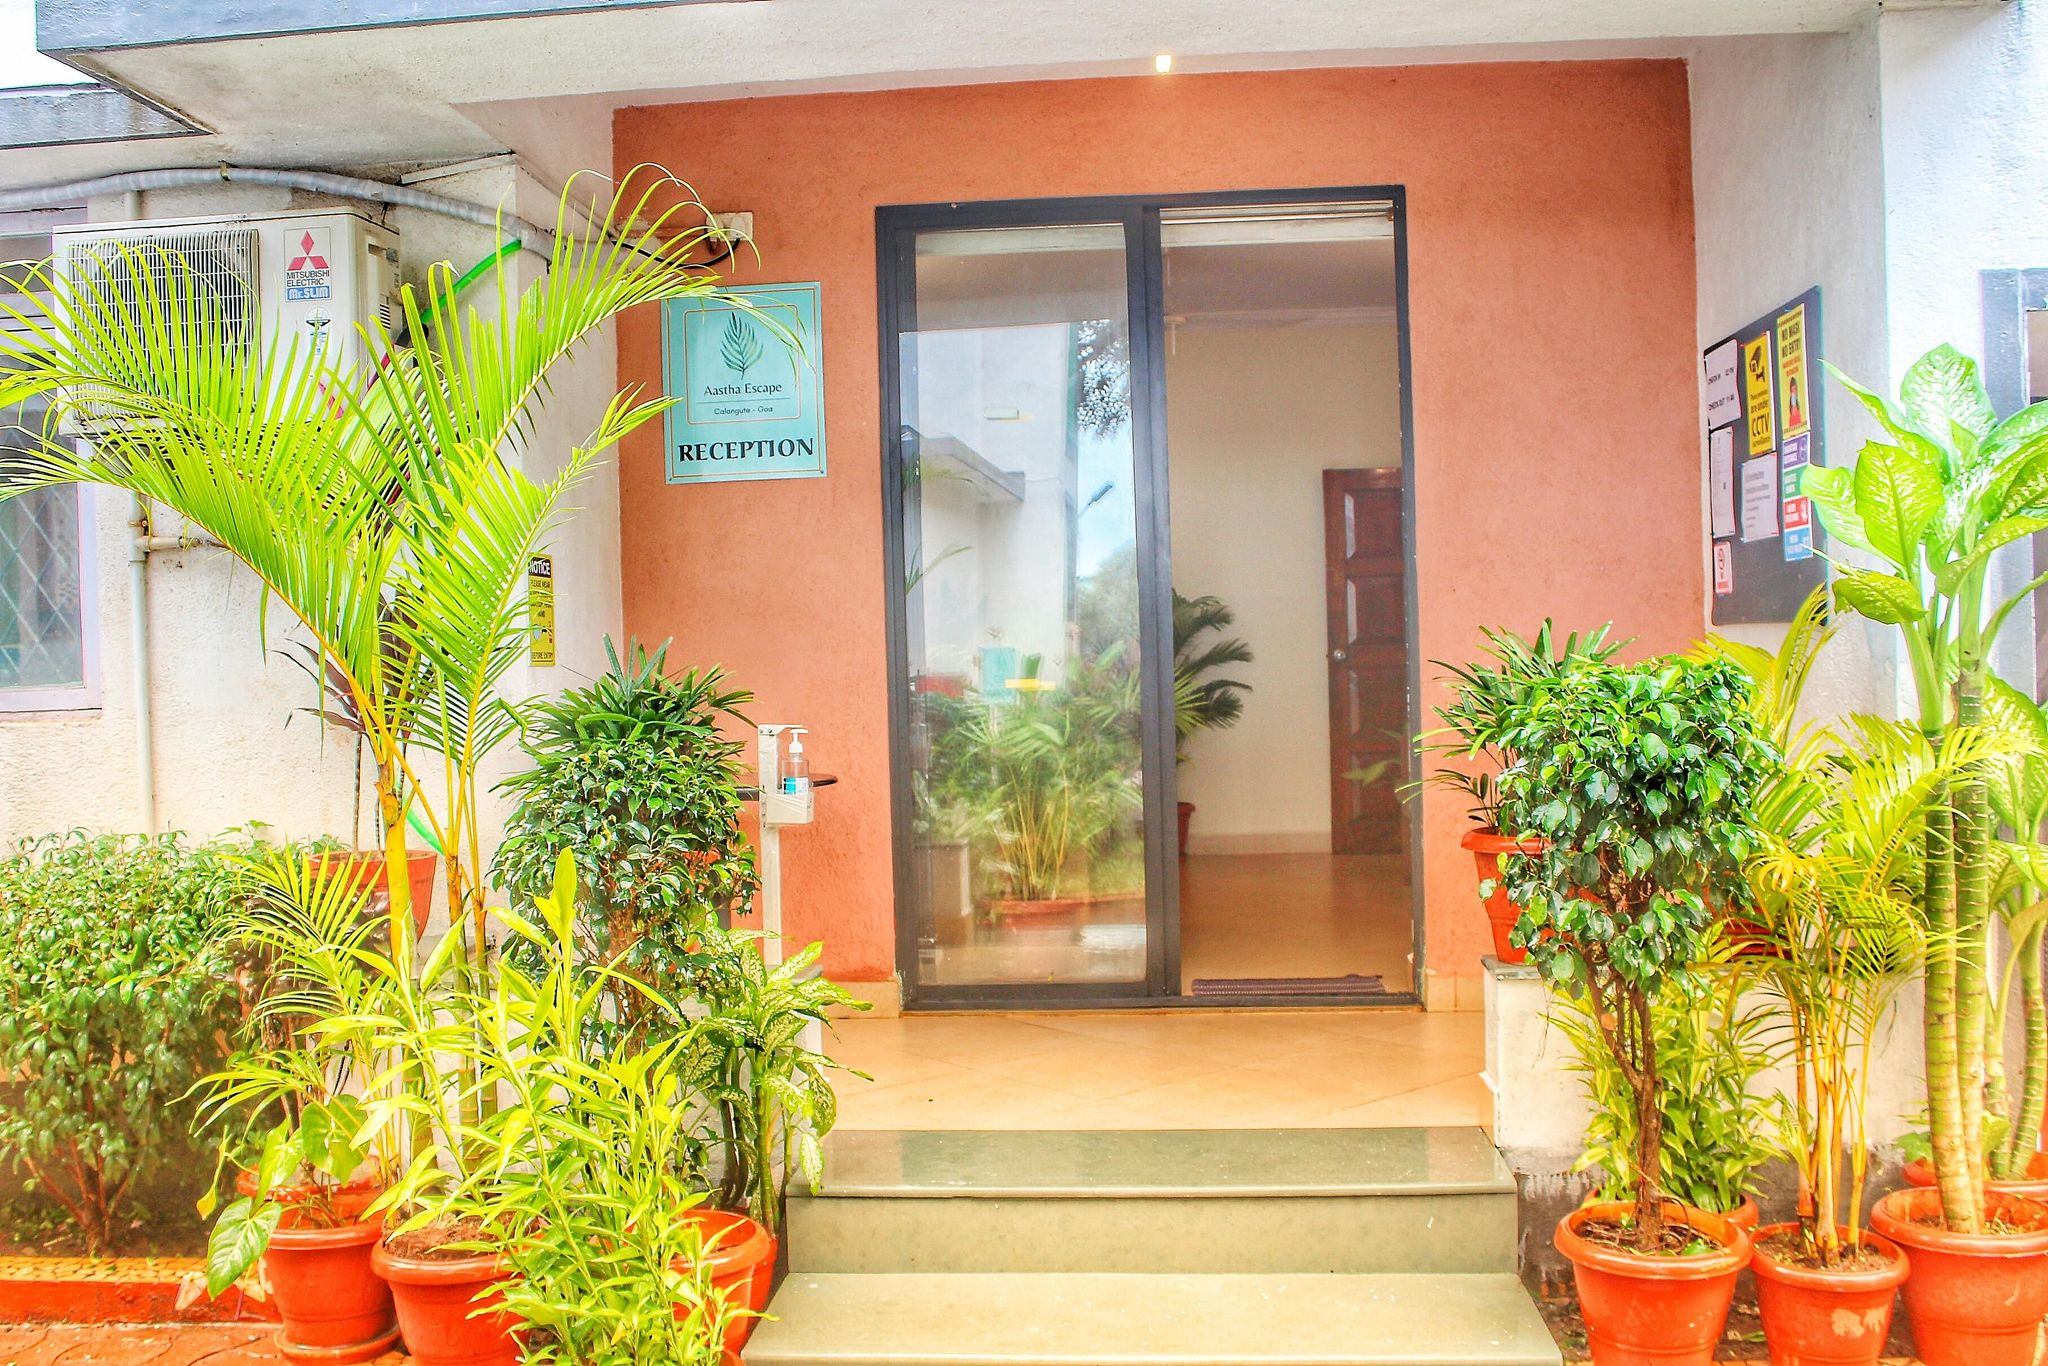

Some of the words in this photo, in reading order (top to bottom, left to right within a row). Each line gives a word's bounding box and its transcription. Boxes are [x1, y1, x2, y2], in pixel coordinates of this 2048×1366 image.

[286, 270, 330, 279] MITSUBISHI
[286, 278, 325, 287] ELECTRIC
[703, 384, 741, 396] Aastha
[744, 383, 783, 396] Escape
[714, 407, 751, 416] Calangute
[1752, 412, 1770, 437] CCTV
[678, 438, 813, 462] RECEPTION
[529, 560, 551, 576] NOTICE
